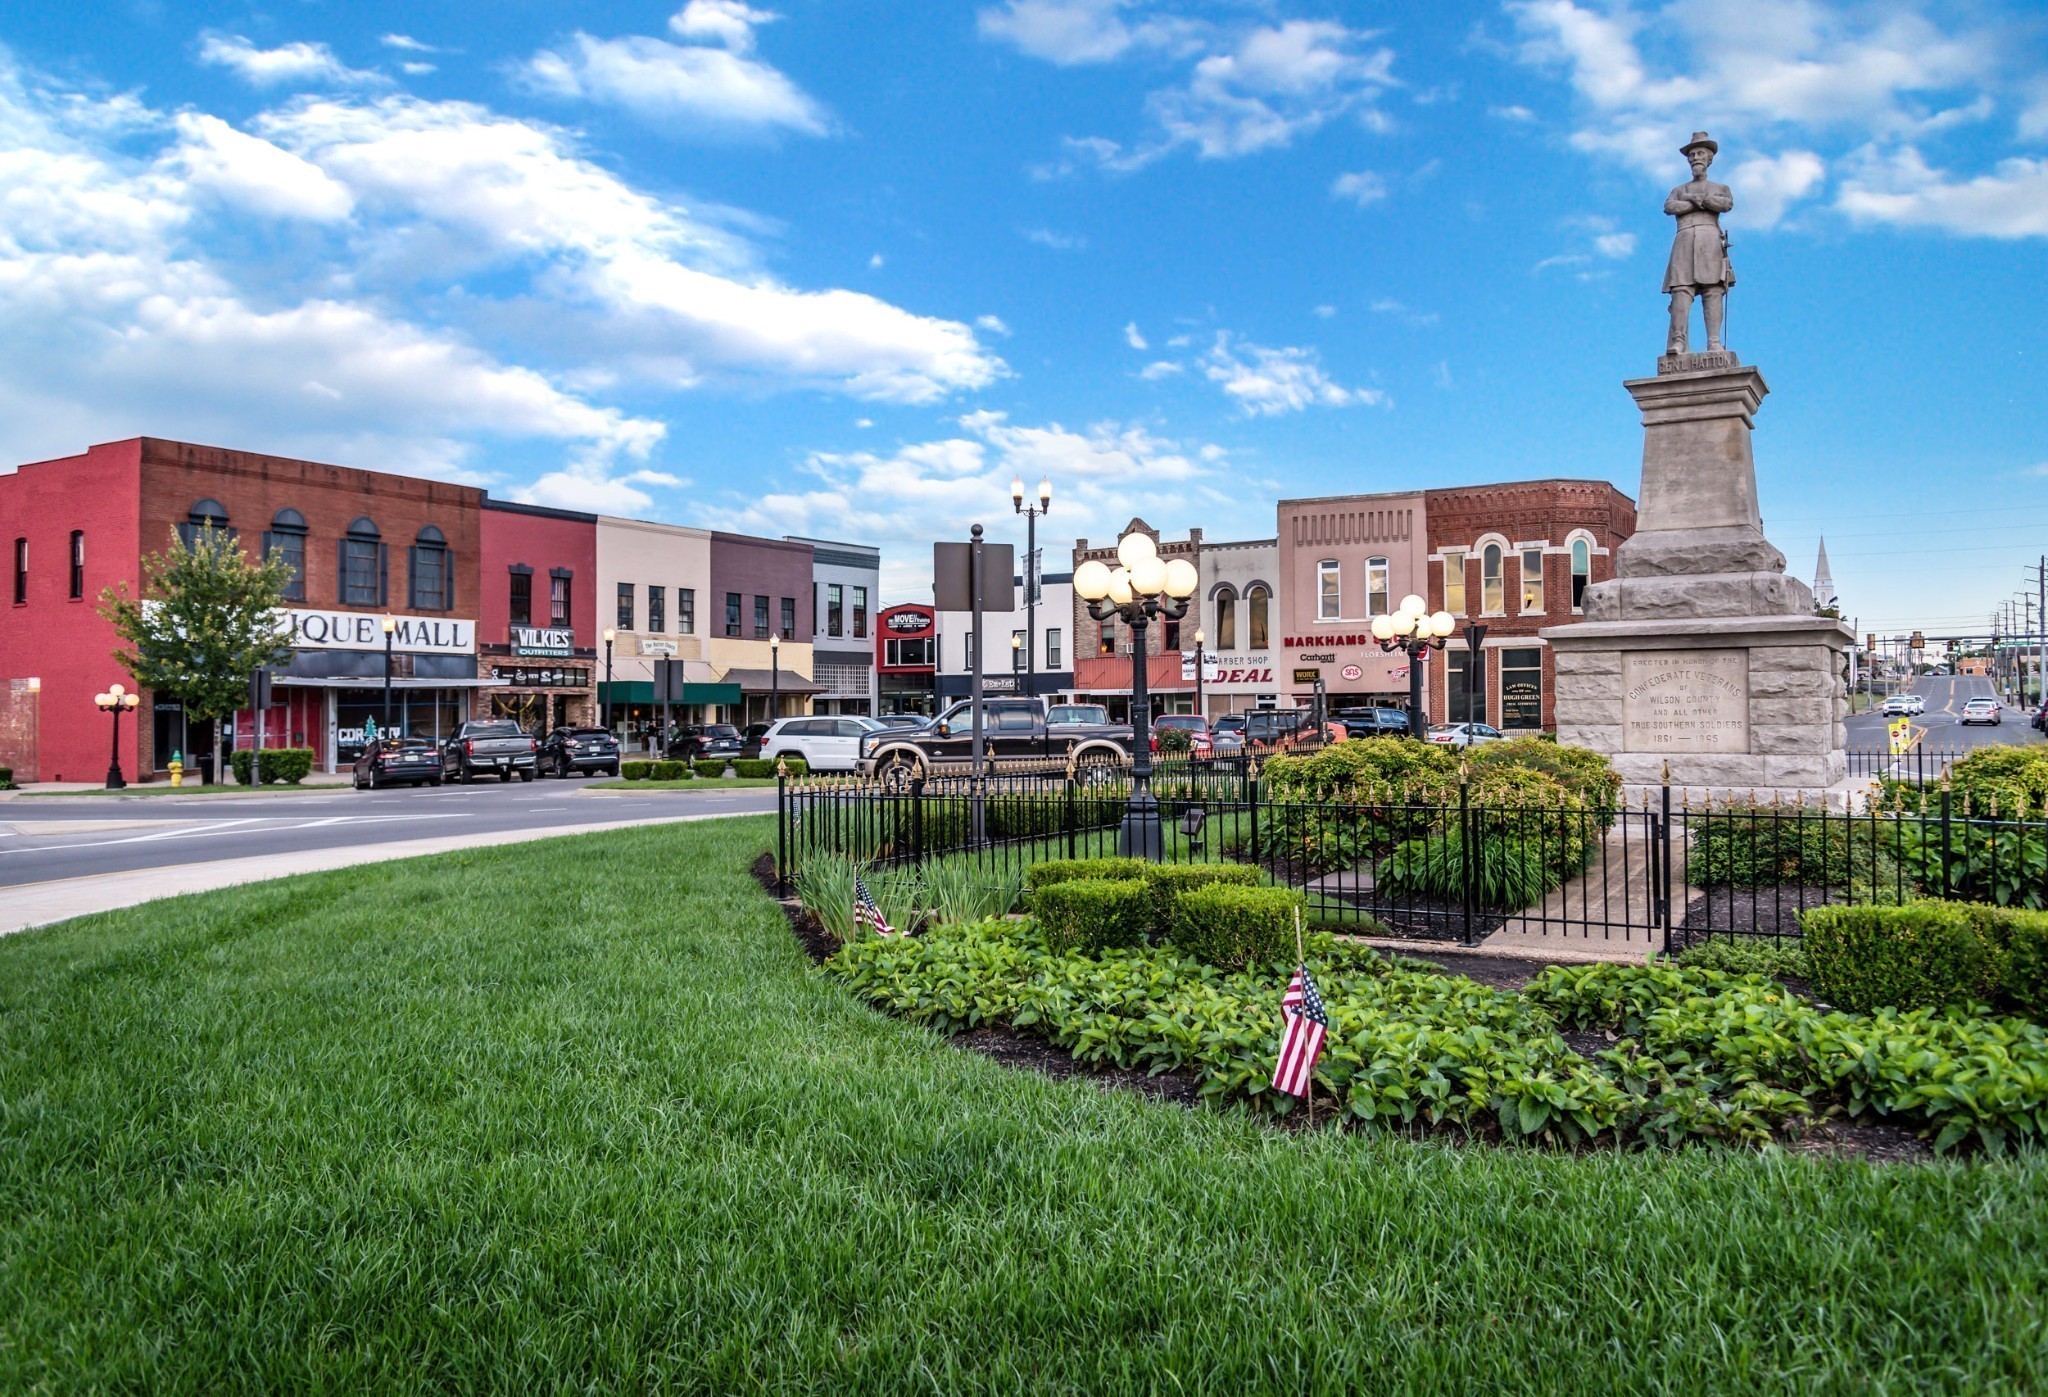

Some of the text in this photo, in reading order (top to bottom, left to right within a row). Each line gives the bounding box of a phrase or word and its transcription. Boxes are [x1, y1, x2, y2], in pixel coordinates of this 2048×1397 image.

[1691, 355, 1731, 370] HATTON
[394, 619, 468, 648] MALL
[518, 629, 570, 648] WILKIE'S
[1284, 634, 1367, 648] MARKHAMS
[519, 648, 569, 656] OUTFITTERS
[1360, 651, 1404, 659] FLORSHEIM
[1218, 656, 1268, 665] ARBER SHOP
[1300, 653, 1335, 661] Carhartt
[1516, 682, 1538, 690] OFFICES
[1629, 670, 1742, 700] CONFEDERATE VETERANS
[1649, 695, 1721, 704] WILSON COUNTY
[1692, 708, 1717, 716] OTHER
[1631, 720, 1743, 730] TRUE SOUTHERN SOLDIERS
[377, 727, 401, 740] CTY
[1653, 735, 1672, 743] 1861
